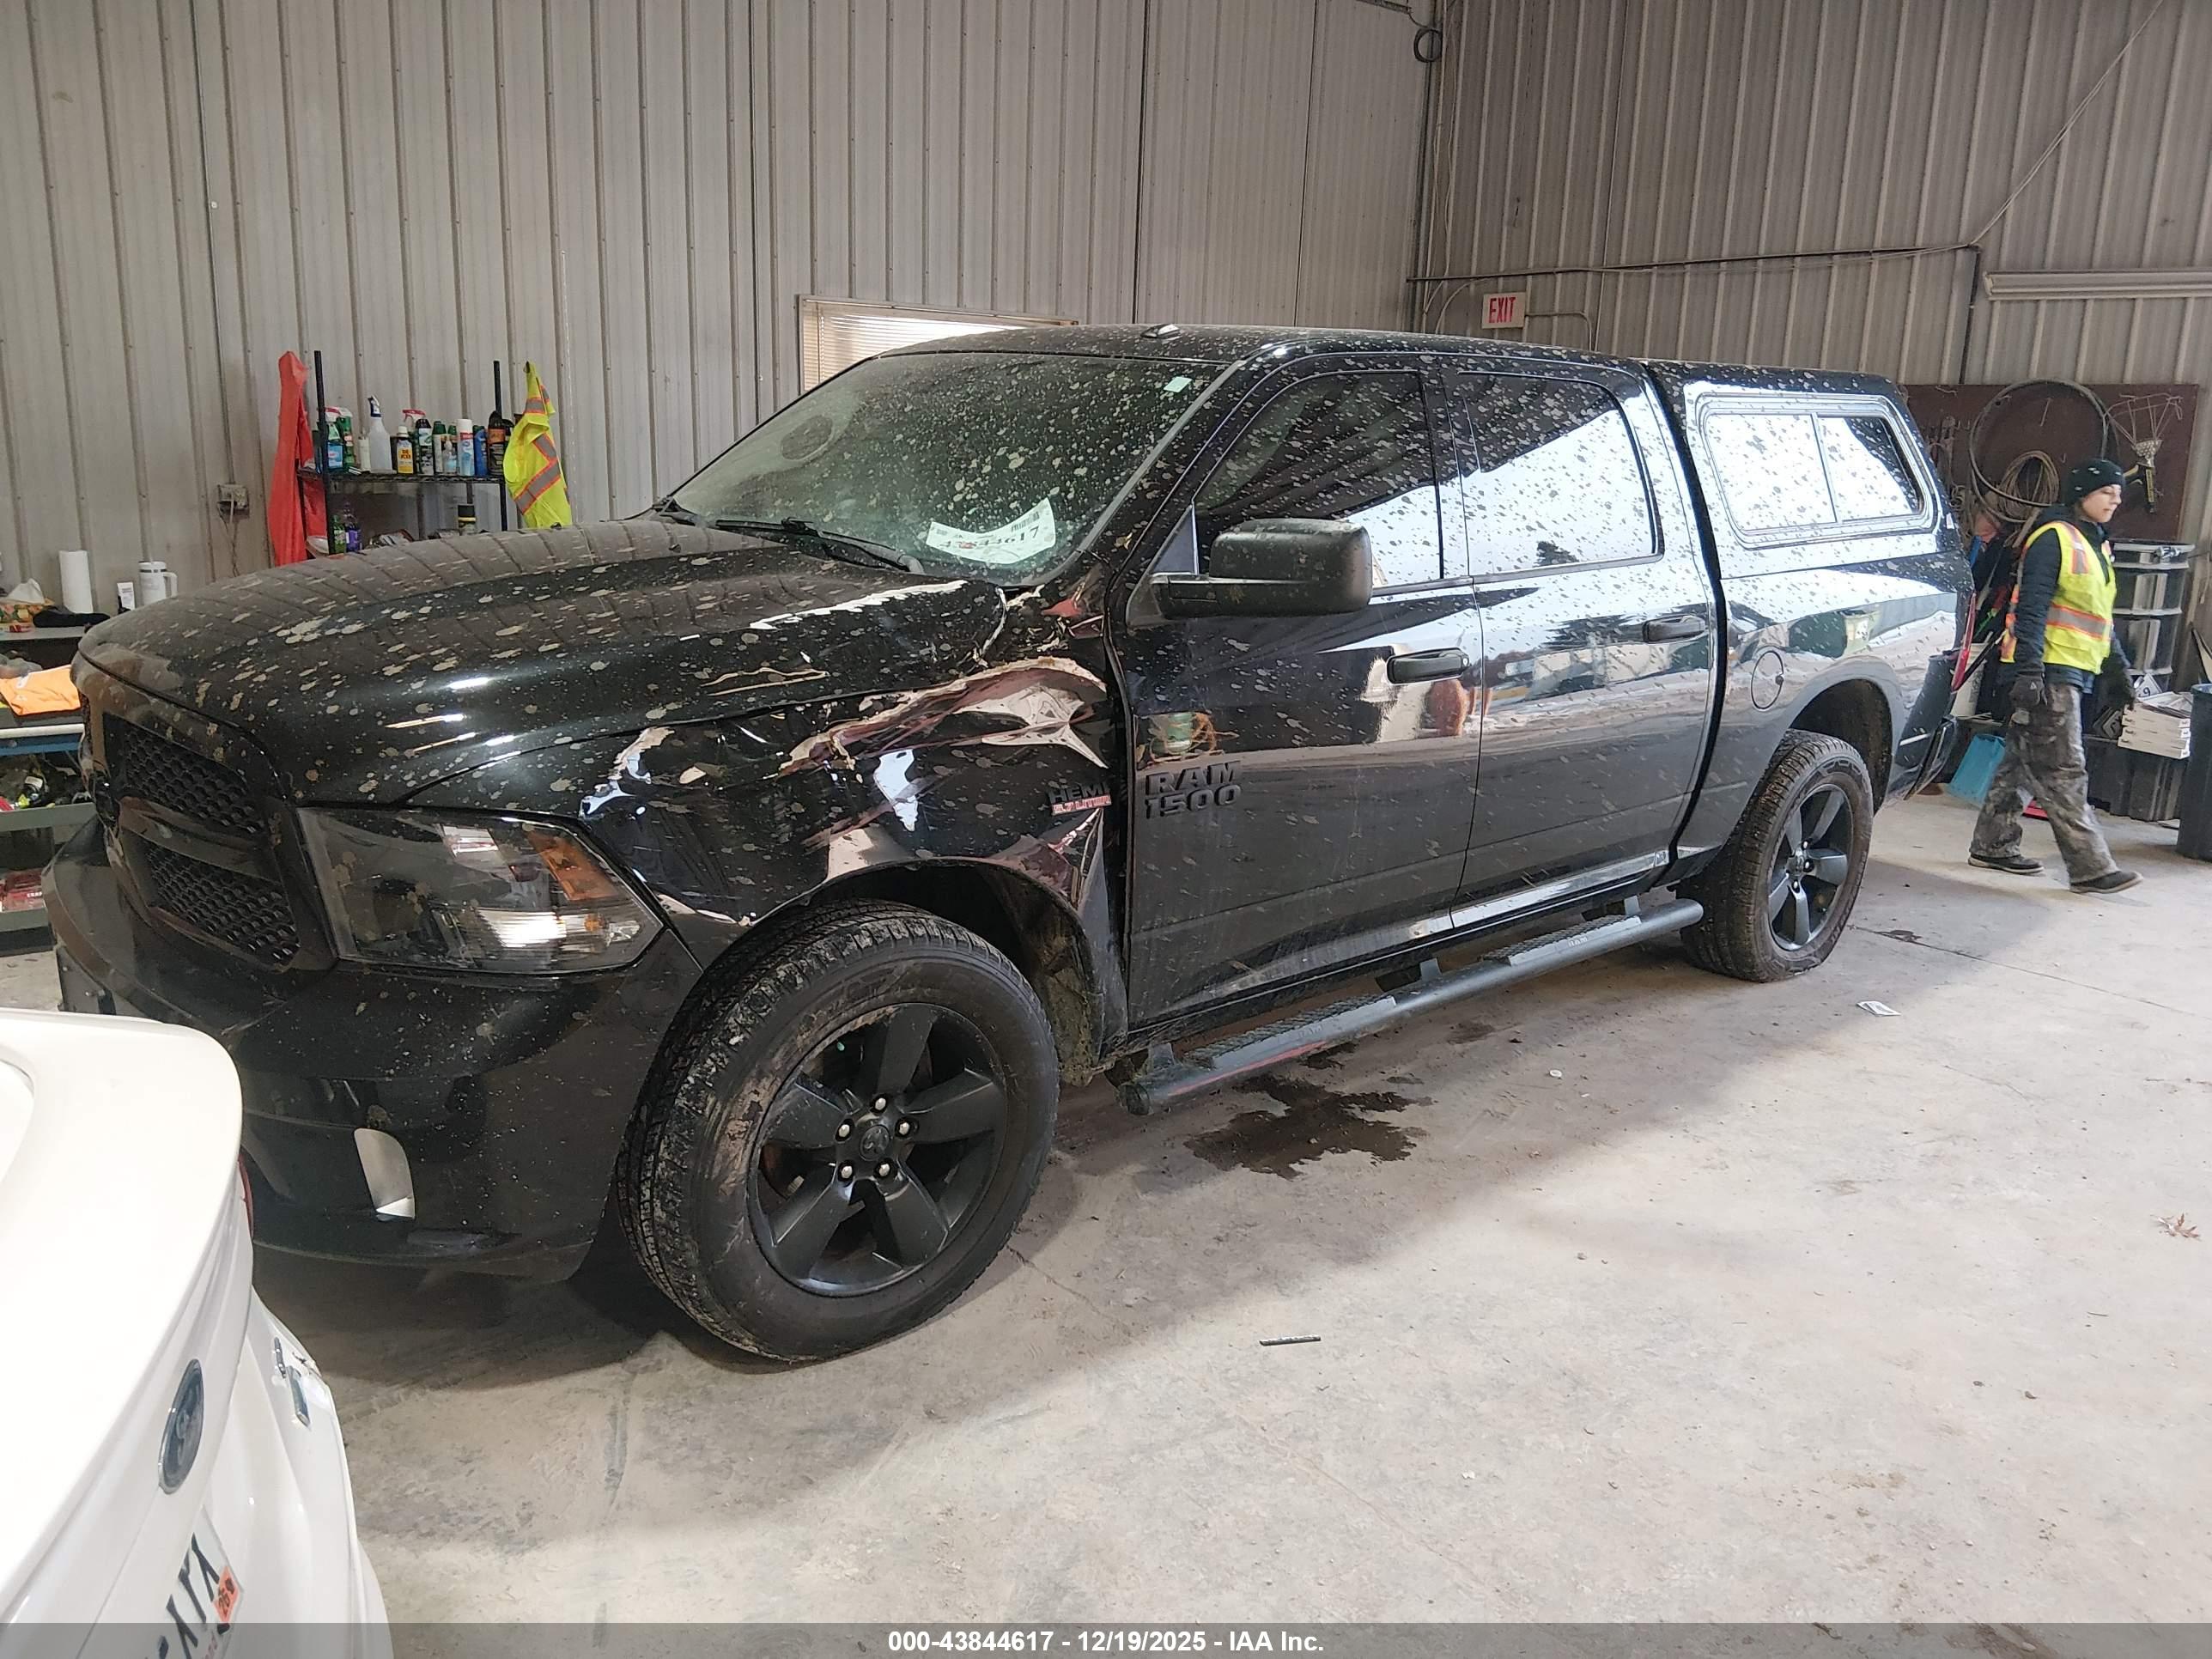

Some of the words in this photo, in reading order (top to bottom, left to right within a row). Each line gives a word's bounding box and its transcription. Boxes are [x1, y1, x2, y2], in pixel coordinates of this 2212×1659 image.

[1488, 296, 1516, 324] EXIT
[1047, 781, 1111, 805] HEMI
[1145, 760, 1242, 795] RAM
[1145, 784, 1243, 819] 1500
